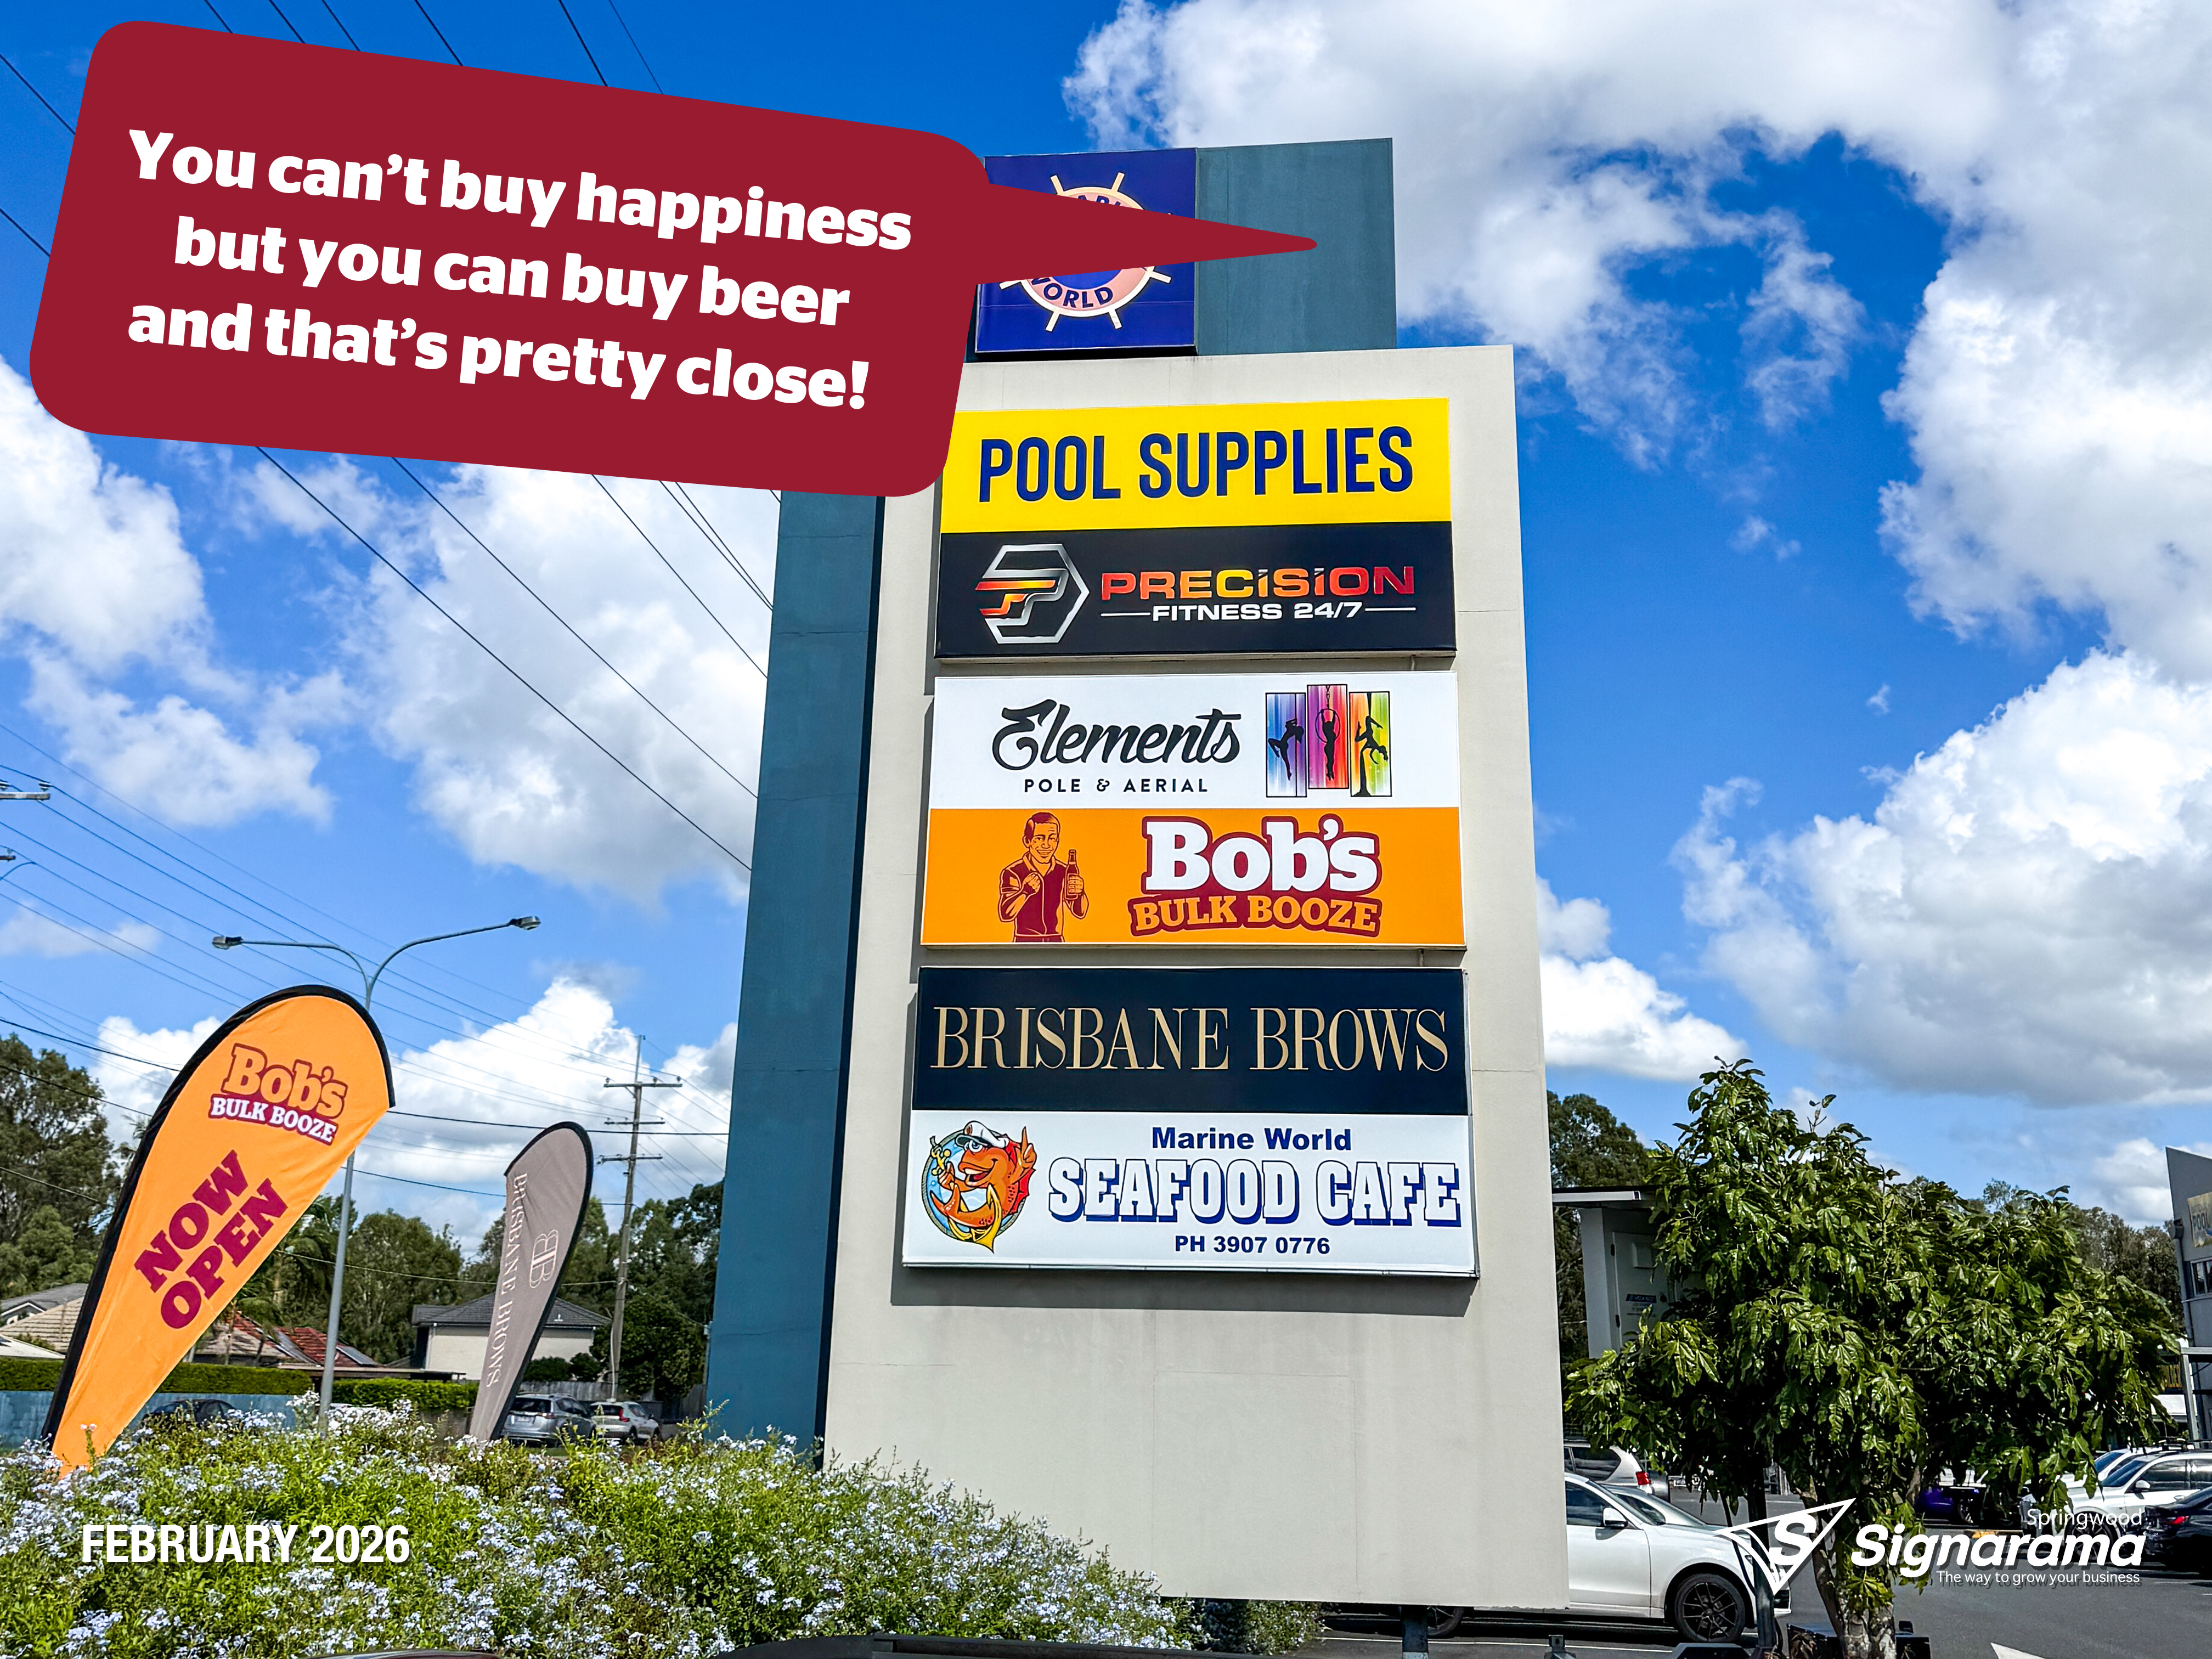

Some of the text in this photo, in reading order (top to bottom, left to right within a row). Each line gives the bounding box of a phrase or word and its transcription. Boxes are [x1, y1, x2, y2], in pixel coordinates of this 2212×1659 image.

[979, 426, 1413, 503] POOL SUPPLIES
[1153, 601, 1363, 622] FITNESS 24/7
[991, 698, 1242, 771] Elements
[1024, 778, 1208, 793] POLE & AERIAL
[1146, 818, 1378, 893] Bob's
[1133, 895, 1378, 932] BULK BOOZE
[930, 1007, 1448, 1071] BRISBANE BROWS
[221, 1043, 348, 1119] Bob's
[210, 1097, 337, 1143] BULK BOOZE
[1152, 1127, 1352, 1152] Marine World
[134, 1149, 249, 1294] NOW
[1048, 1156, 1463, 1228] SEAFOOD CAFE
[161, 1177, 289, 1329] OPEN
[1175, 1235, 1331, 1255] PH 3907 0776
[486, 1300, 513, 1387] BROWS
